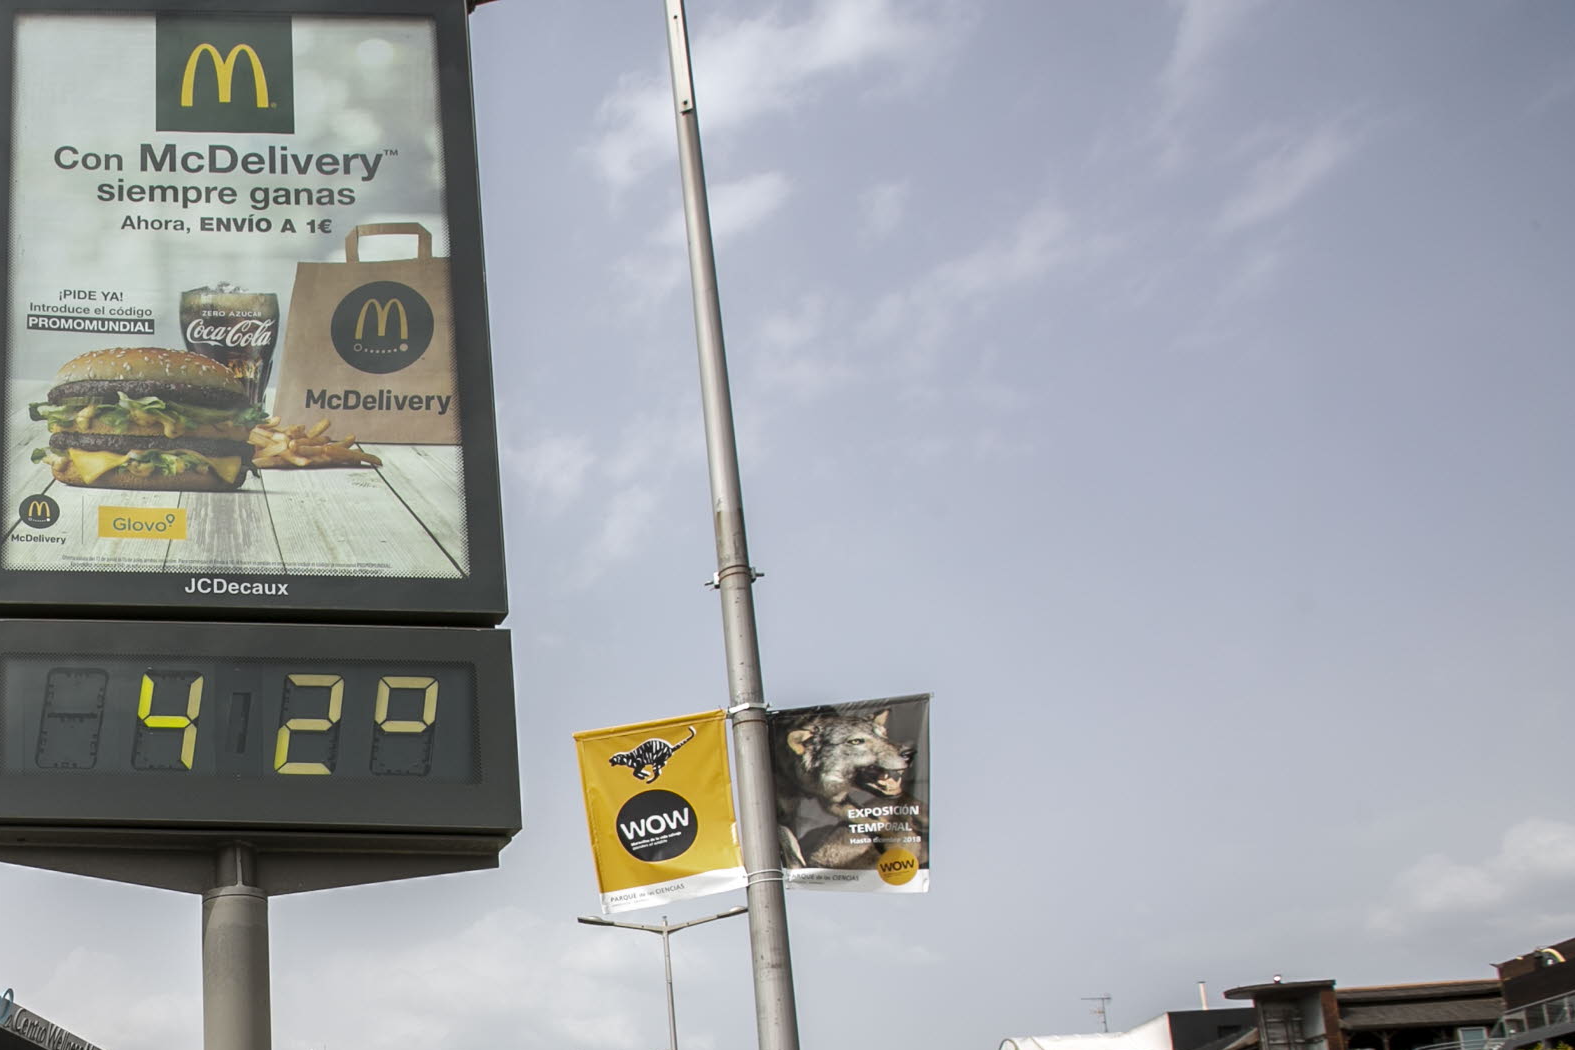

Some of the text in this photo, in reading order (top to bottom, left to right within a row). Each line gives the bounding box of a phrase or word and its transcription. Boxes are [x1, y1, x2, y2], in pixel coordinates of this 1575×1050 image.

[54, 145, 123, 171] Con
[97, 178, 356, 211] siempre ganas
[121, 214, 332, 234] Ahora, ENVÍO A 1€
[59, 290, 124, 302] ¡PIDE YA!
[30, 302, 153, 318] Introduce el código
[28, 316, 154, 332] PROMOMUNDIAL
[305, 389, 452, 415] McDelivery
[112, 517, 167, 532] Glovo
[11, 534, 66, 545] McDelivery
[184, 577, 289, 595] JCDecaux
[847, 804, 920, 819] EXPOSICIÓN
[620, 807, 689, 840] WOW
[849, 822, 913, 834] TEMPORAL
[849, 837, 872, 845] Hasta
[903, 835, 922, 843] 2018
[879, 859, 915, 873] WOW
[610, 893, 637, 902] PARQUE
[655, 883, 685, 895] CIENCIAS
[13, 1007, 46, 1043] Centro
